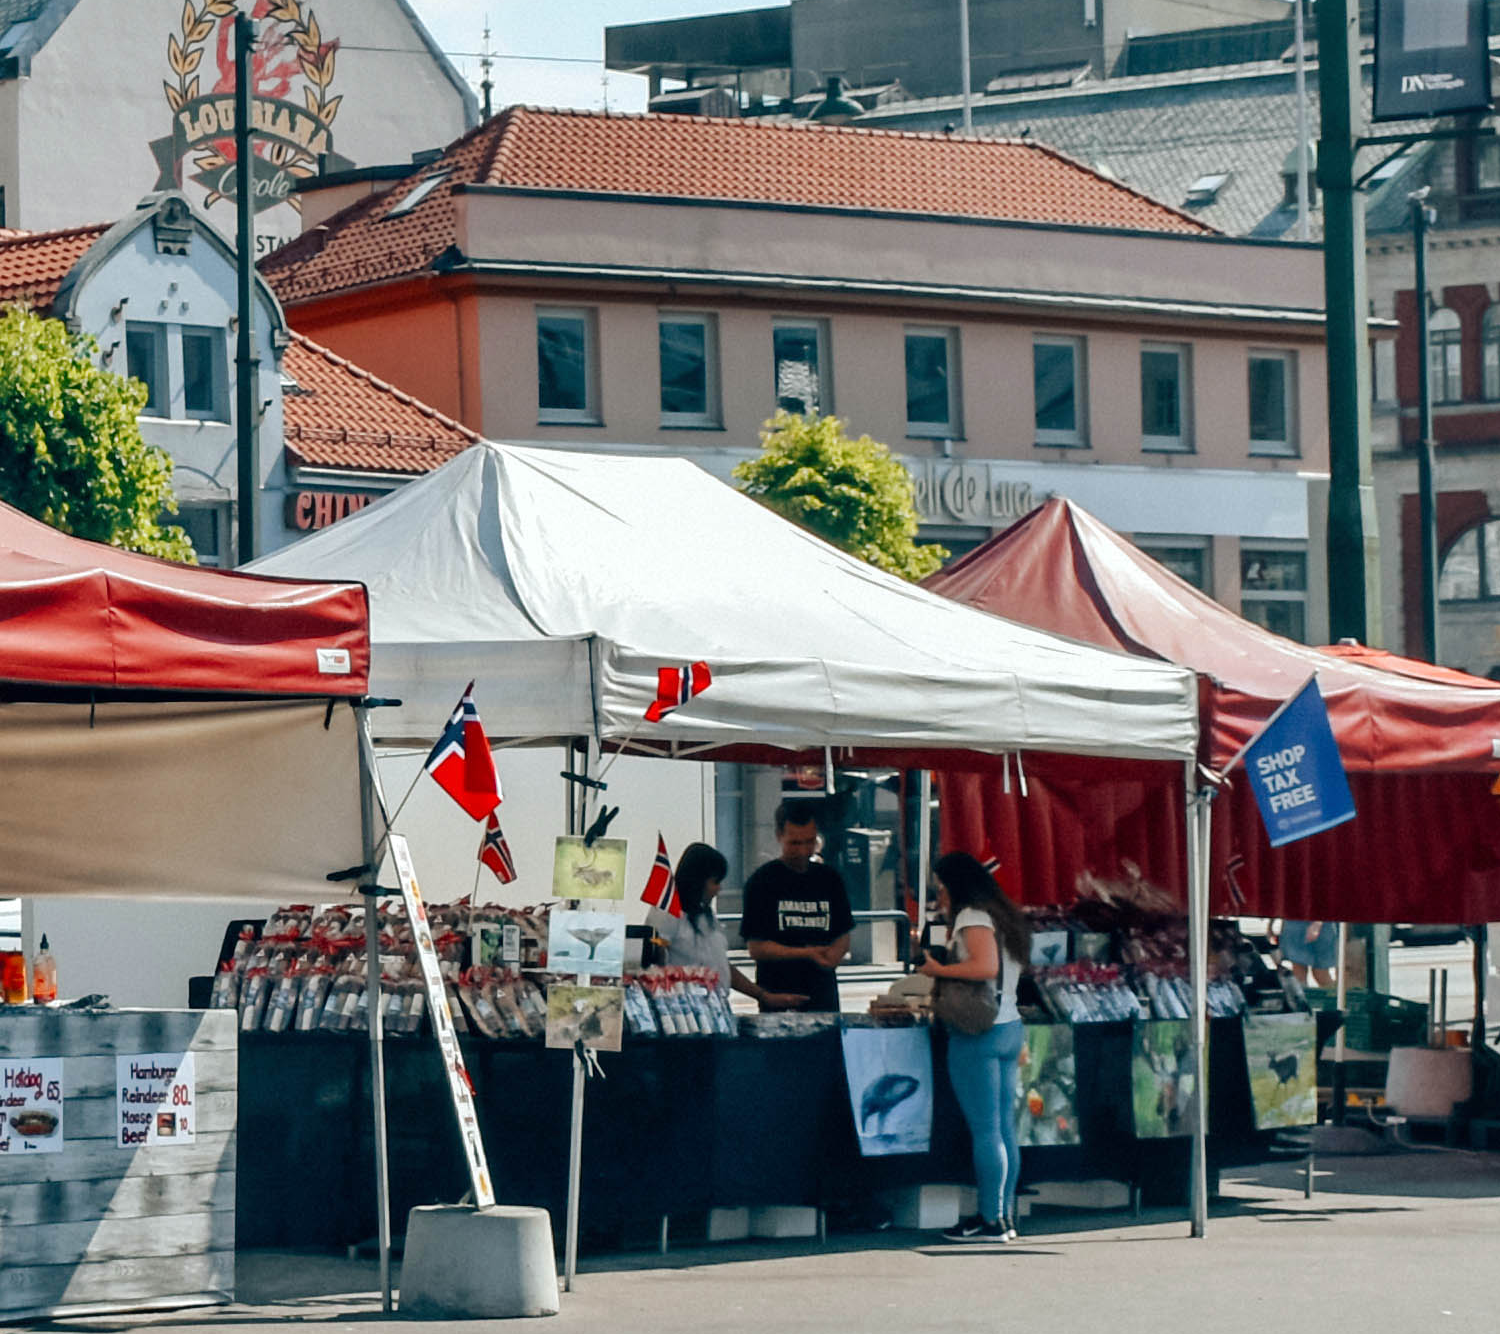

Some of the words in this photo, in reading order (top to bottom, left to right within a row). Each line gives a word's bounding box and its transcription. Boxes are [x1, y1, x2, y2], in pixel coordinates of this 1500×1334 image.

[179, 98, 328, 154] LOUSIANA
[218, 164, 290, 197] Cole
[296, 490, 377, 529] CHIN
[1257, 745, 1306, 775] SHOP
[1262, 768, 1301, 793] TAX
[1269, 784, 1317, 814] FREE
[122, 1084, 169, 1104] Reindeer
[122, 1110, 153, 1124] Moose
[122, 1126, 150, 1144] Beef
